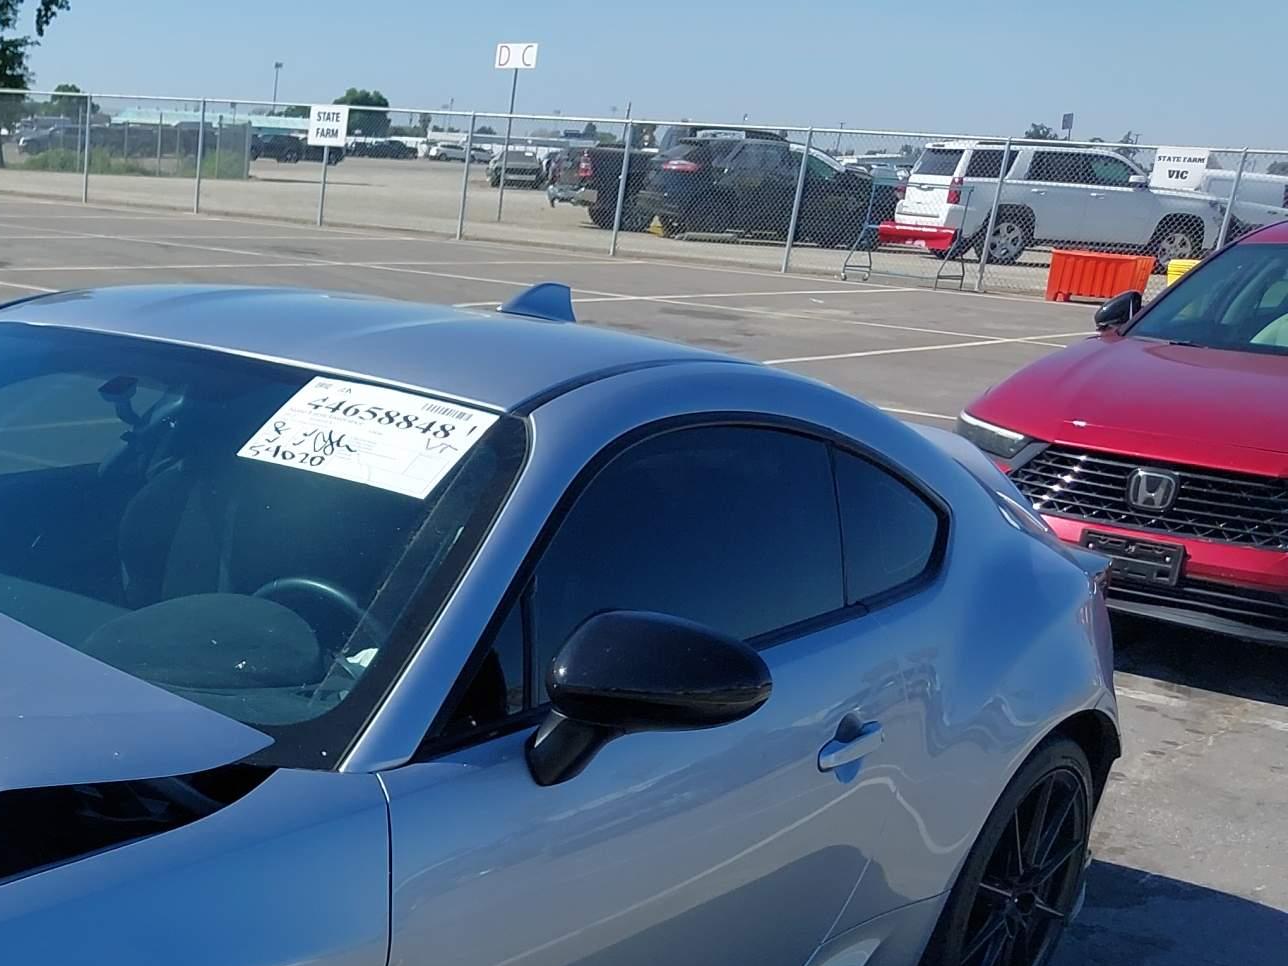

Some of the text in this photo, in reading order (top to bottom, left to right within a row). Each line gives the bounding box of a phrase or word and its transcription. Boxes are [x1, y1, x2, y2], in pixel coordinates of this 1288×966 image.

[498, 45, 534, 66] D C
[316, 111, 341, 122] STATE
[315, 127, 339, 138] FARM
[1157, 155, 1206, 164] STATE FARM
[1167, 169, 1189, 180] VIC
[307, 396, 456, 438] 44658848
